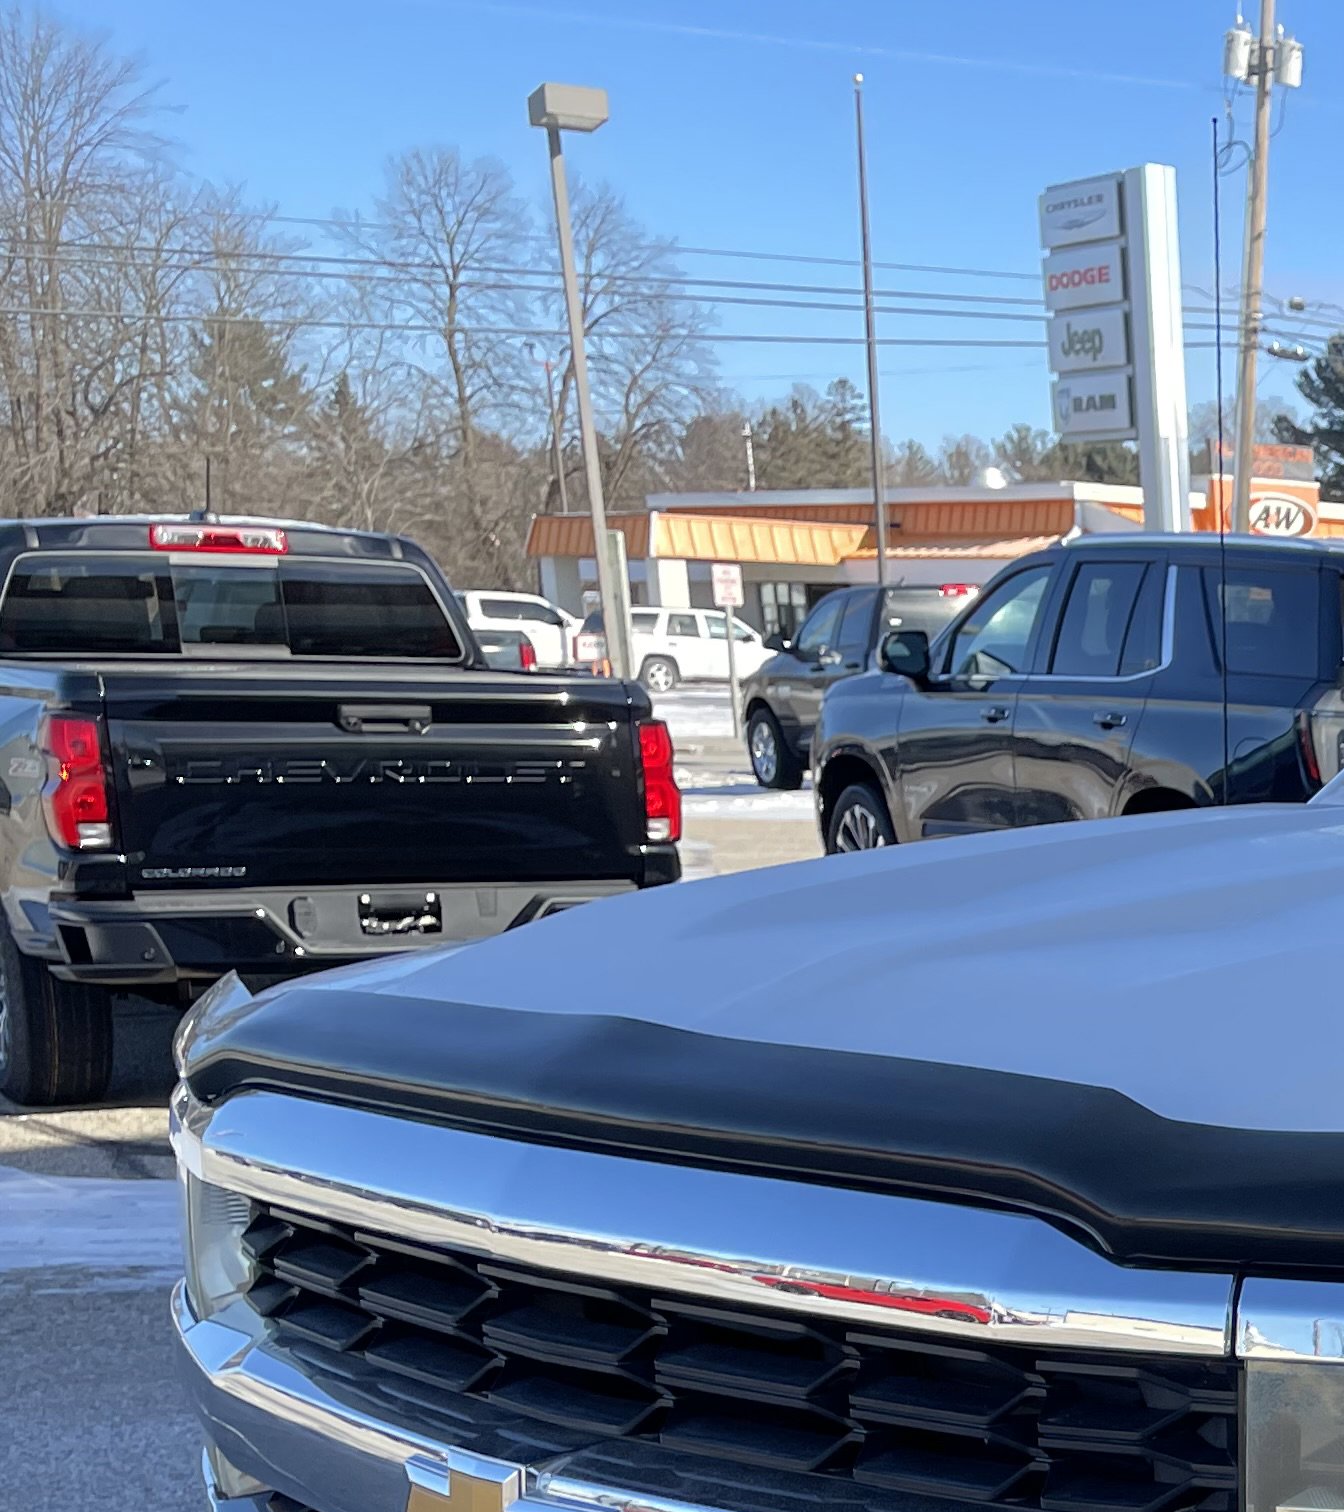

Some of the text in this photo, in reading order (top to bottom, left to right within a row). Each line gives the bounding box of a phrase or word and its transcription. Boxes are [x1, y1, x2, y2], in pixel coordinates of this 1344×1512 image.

[1048, 265, 1111, 291] DODGE
[1061, 321, 1103, 361] Jeep
[1072, 394, 1116, 412] RAM
[176, 759, 587, 784] CHEVROLET
